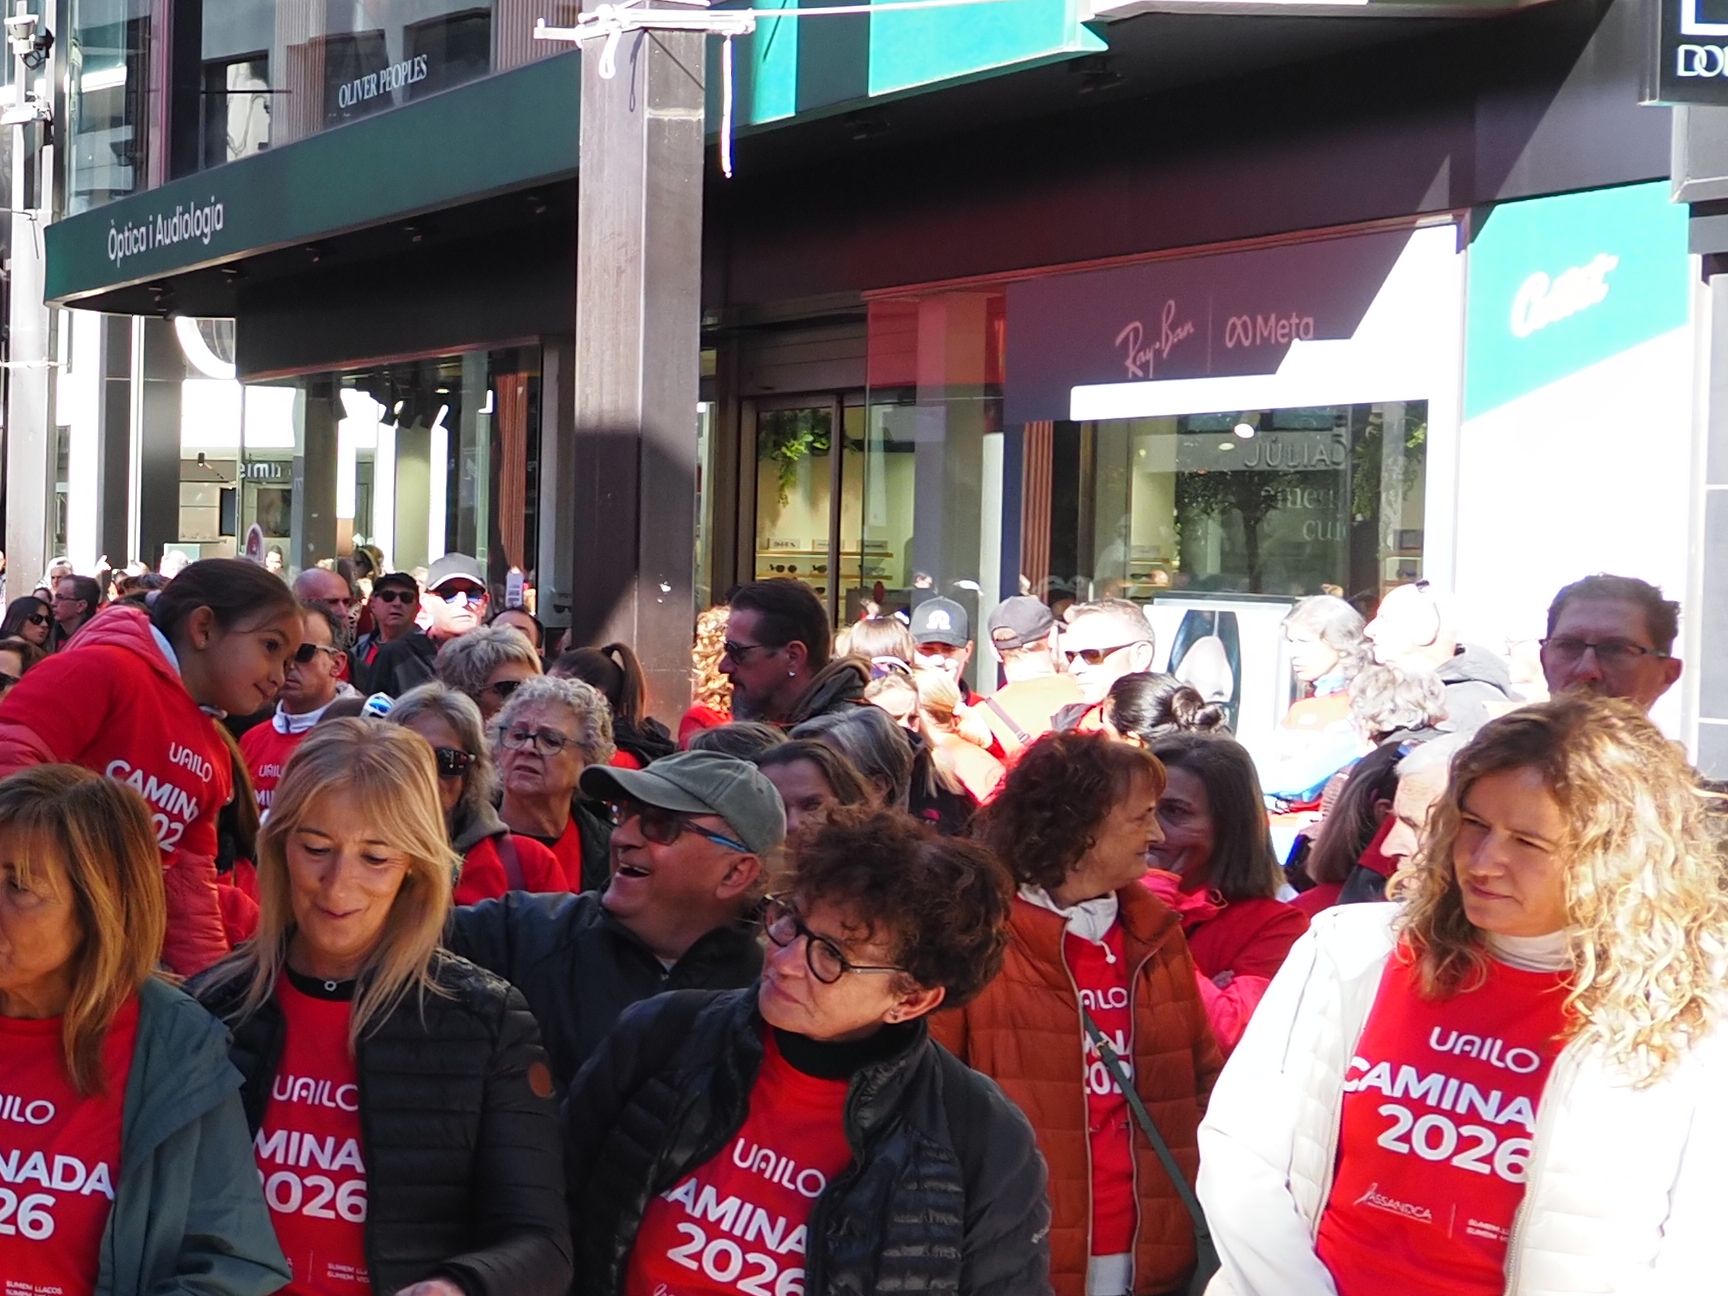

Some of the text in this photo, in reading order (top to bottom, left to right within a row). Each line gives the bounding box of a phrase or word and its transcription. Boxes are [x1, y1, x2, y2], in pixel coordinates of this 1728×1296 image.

[338, 53, 428, 108] OLIVER PEOPLES
[108, 195, 224, 267] Òptica i Audiologia
[1255, 312, 1315, 341] Meta
[169, 742, 213, 784] UAILO
[1428, 1025, 1540, 1074] UAILO
[1344, 1054, 1539, 1134] CAMINA
[254, 1126, 366, 1174] MINA
[733, 1138, 827, 1198] UAILO
[1377, 1104, 1534, 1184] 2026
[257, 1168, 367, 1223] 026
